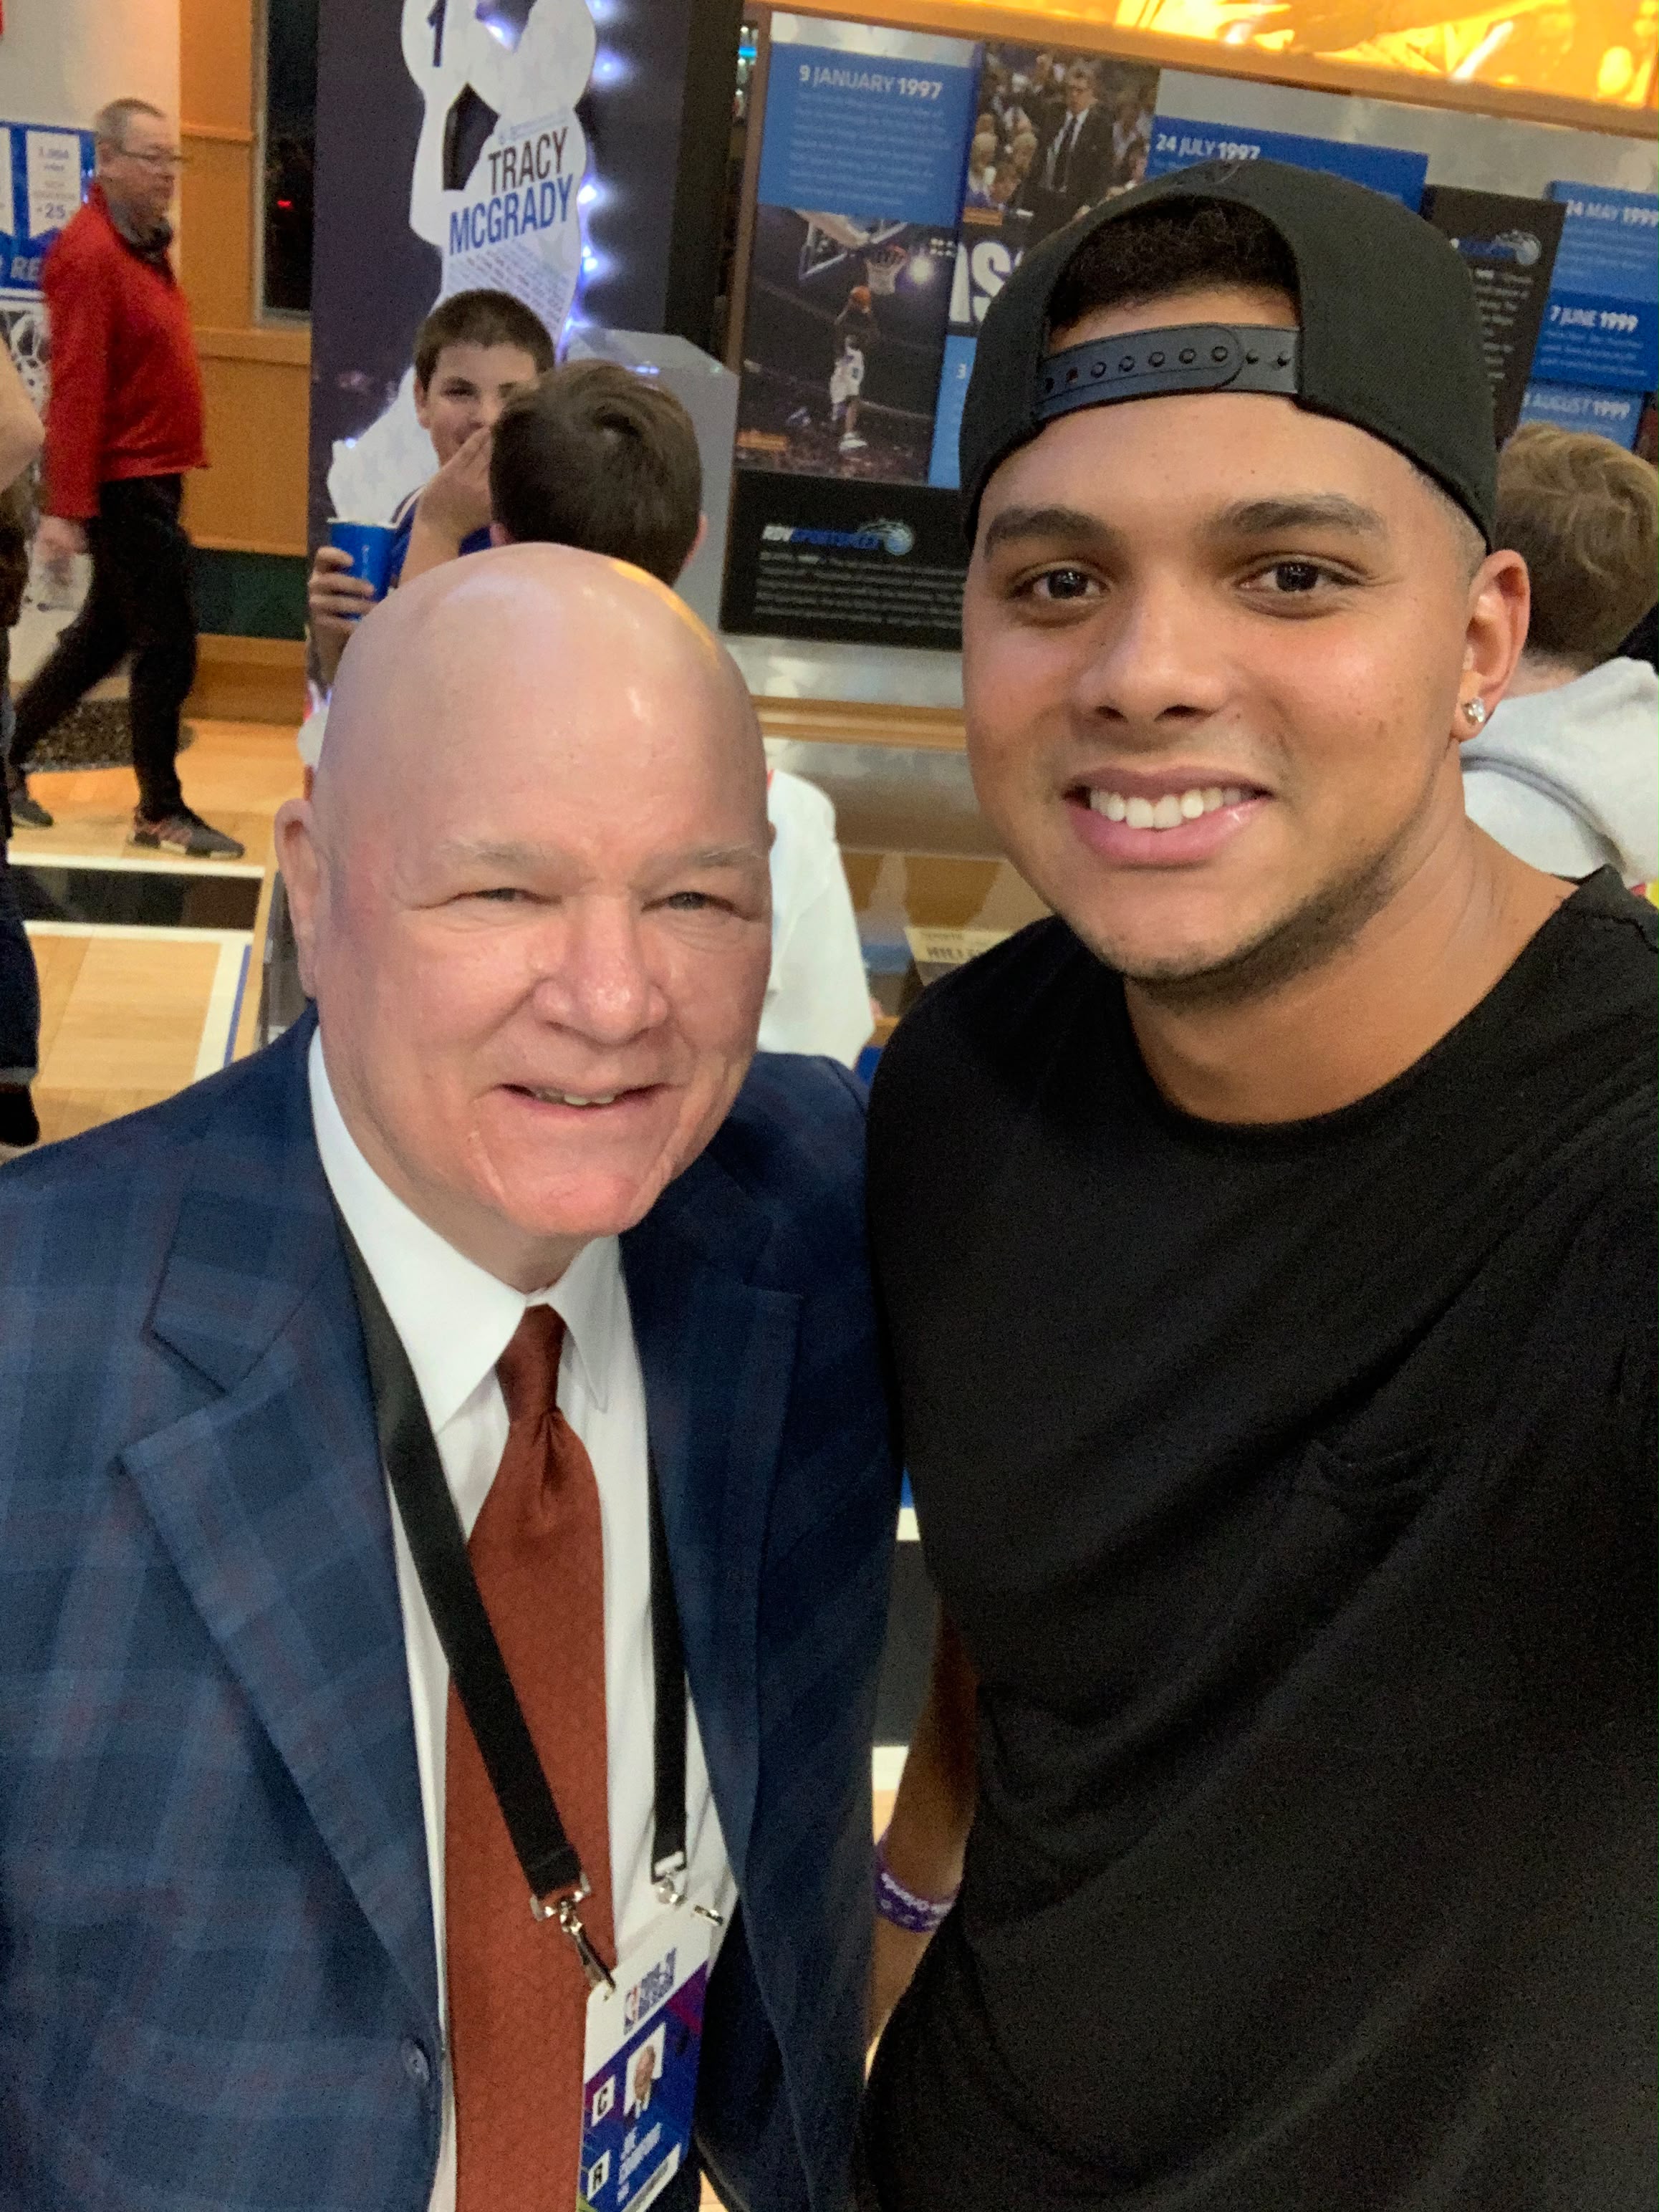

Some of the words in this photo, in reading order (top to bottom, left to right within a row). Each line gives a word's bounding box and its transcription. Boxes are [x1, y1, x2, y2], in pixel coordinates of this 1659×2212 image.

[427, 0, 448, 67] 1
[799, 64, 810, 82] 9
[812, 67, 895, 93] JANUARY
[898, 77, 944, 100] 1997
[489, 126, 568, 196] TRACY
[1156, 133, 1177, 152] 24
[1178, 135, 1216, 157] JULY
[1218, 141, 1261, 160] 1997
[449, 173, 573, 256] MCGRADY
[1559, 307, 1597, 328] JUNE
[1600, 311, 1639, 332] 1999
[1531, 393, 1592, 415] AUGUST
[1593, 400, 1631, 420] 1999
